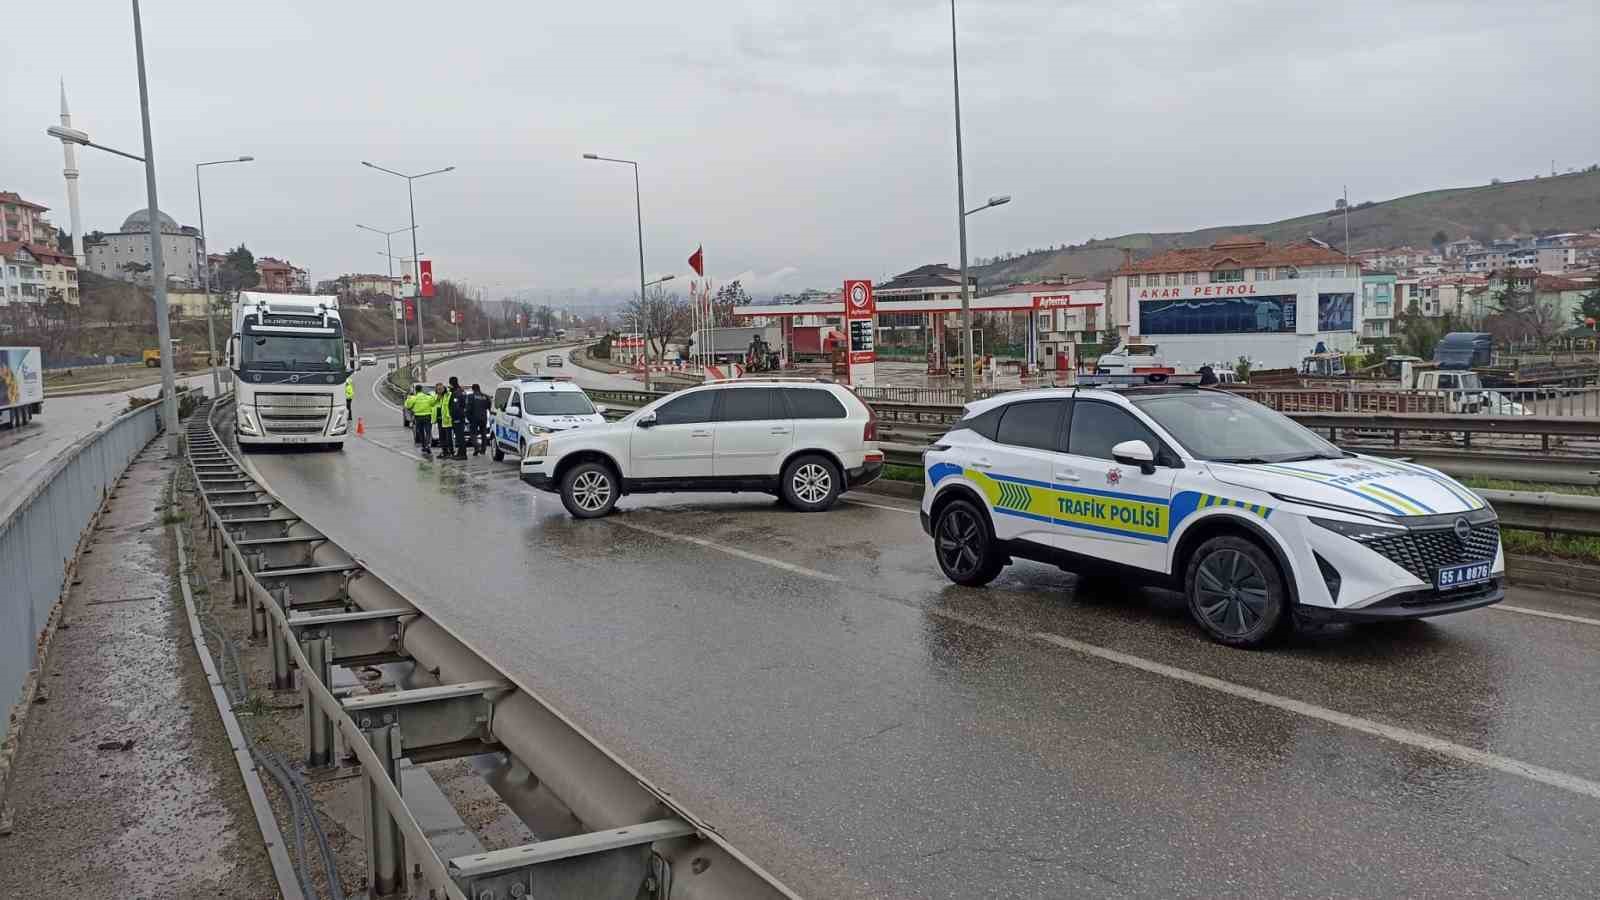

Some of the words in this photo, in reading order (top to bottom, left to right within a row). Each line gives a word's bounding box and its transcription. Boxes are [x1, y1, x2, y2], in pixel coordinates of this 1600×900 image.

[1140, 288, 1180, 298] AKAR
[1193, 285, 1257, 296] PETROL
[1057, 496, 1106, 520] TRAFİK
[1111, 505, 1160, 529] POLİSİ
[1441, 571, 1454, 584] 55
[1457, 569, 1463, 582] A
